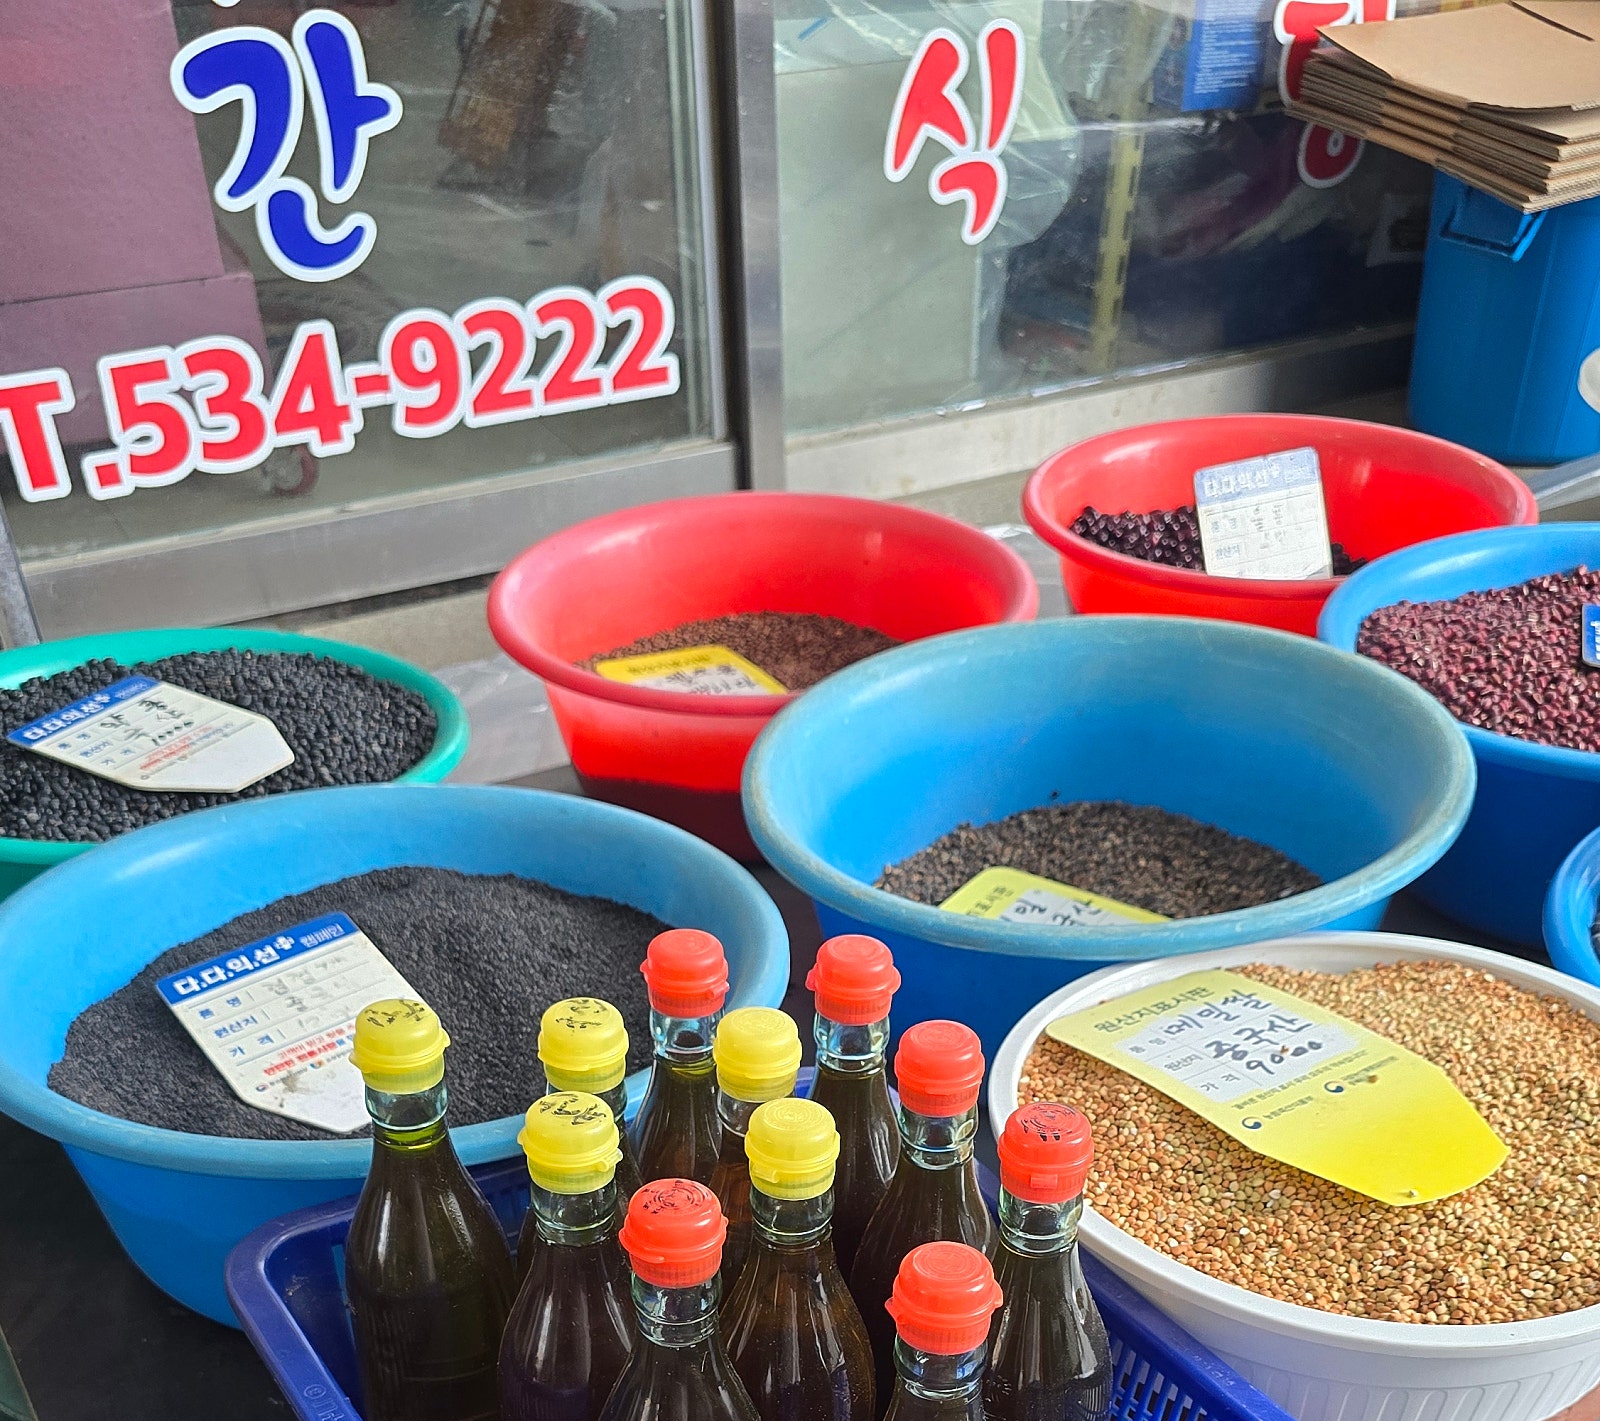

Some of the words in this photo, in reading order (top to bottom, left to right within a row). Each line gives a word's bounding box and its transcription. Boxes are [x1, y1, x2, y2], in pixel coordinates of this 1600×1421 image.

[172, 10, 401, 281] 간
[885, 19, 1024, 244] 식
[0, 277, 679, 501] T.534-9222
[214, 1016, 259, 1039] 원산지
[1094, 986, 1215, 1033] 원산지표시판
[1163, 1053, 1203, 1072] 원산지
[1204, 1013, 1313, 1061] 중국산
